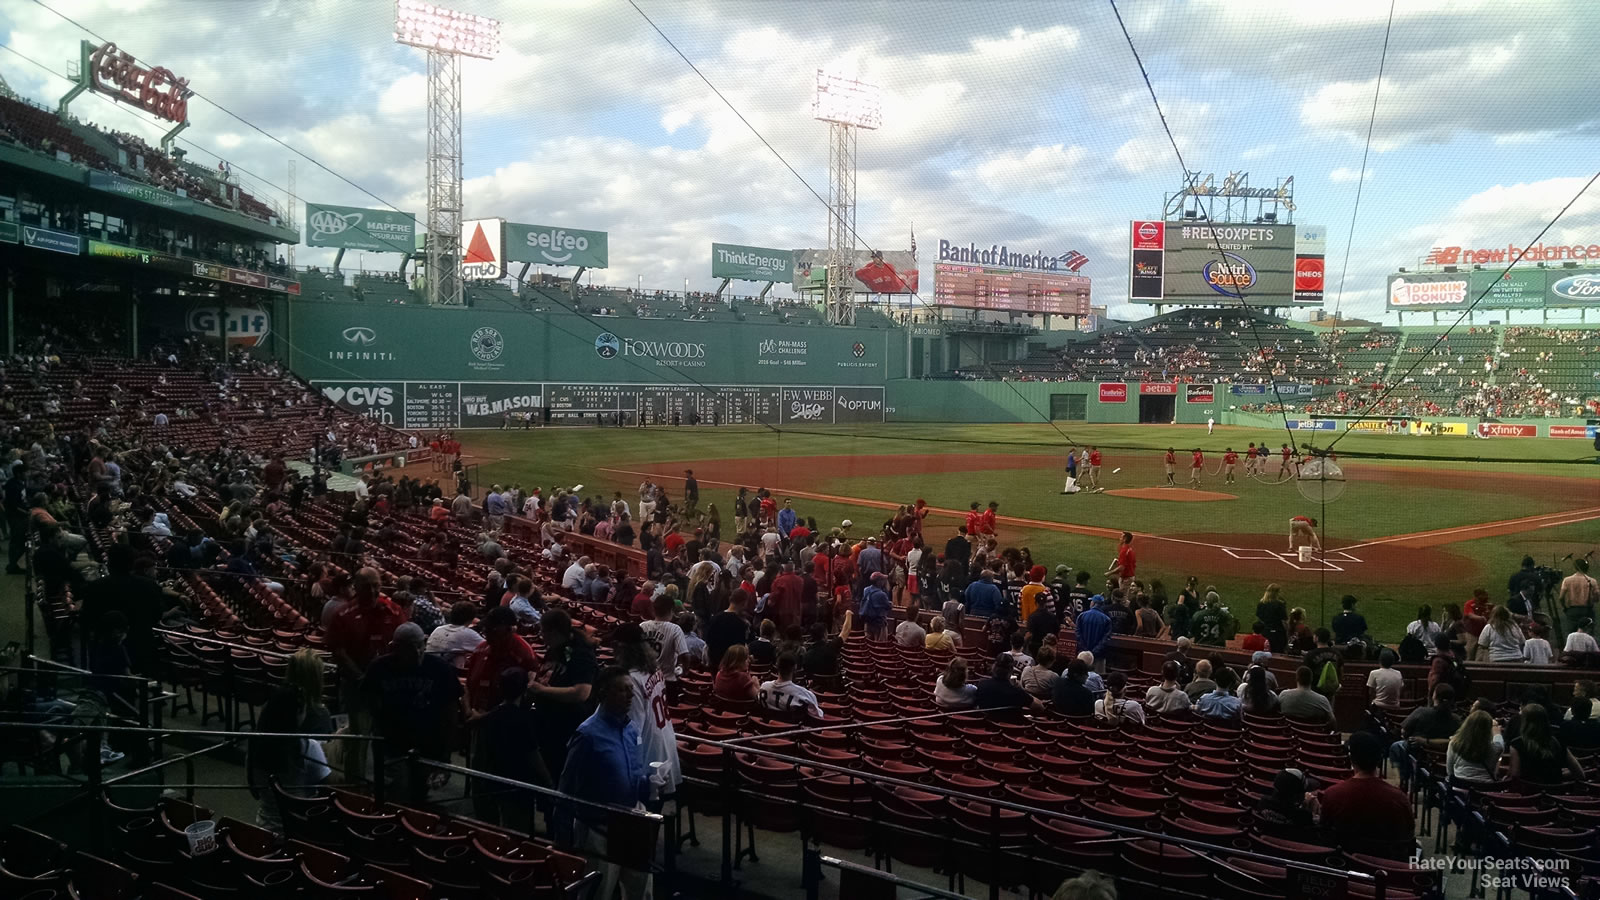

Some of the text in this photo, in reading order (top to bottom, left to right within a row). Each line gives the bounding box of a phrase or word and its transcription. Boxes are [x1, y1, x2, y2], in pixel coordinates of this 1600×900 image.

[366, 221, 411, 233] MAPFRE
[369, 232, 409, 241] INSURANCE
[1182, 226, 1274, 241] #REDSOXPETS
[526, 230, 588, 251] selfeo
[142, 254, 150, 263] VS
[938, 239, 1058, 270] Bank of America
[1462, 243, 1600, 264] new balance
[462, 264, 496, 276] CITGO
[1218, 263, 1245, 275] Nutri
[1209, 271, 1250, 285] Source
[1412, 282, 1465, 293] DUNKIN'
[1568, 278, 1600, 295] For
[1412, 291, 1462, 302] DONUTS
[484, 329, 498, 338] SOX
[624, 338, 704, 358] FOXWOODS
[329, 352, 393, 361] INFINITI
[1146, 384, 1172, 394] aetna
[1187, 388, 1213, 396] Safelite
[346, 386, 394, 406] CVS
[784, 390, 832, 401] F.W. WEBB
[848, 401, 881, 411] OPTUM
[1297, 420, 1324, 429] jetBlue
[1491, 426, 1523, 435] xfinity
[1200, 624, 1220, 638] 34
